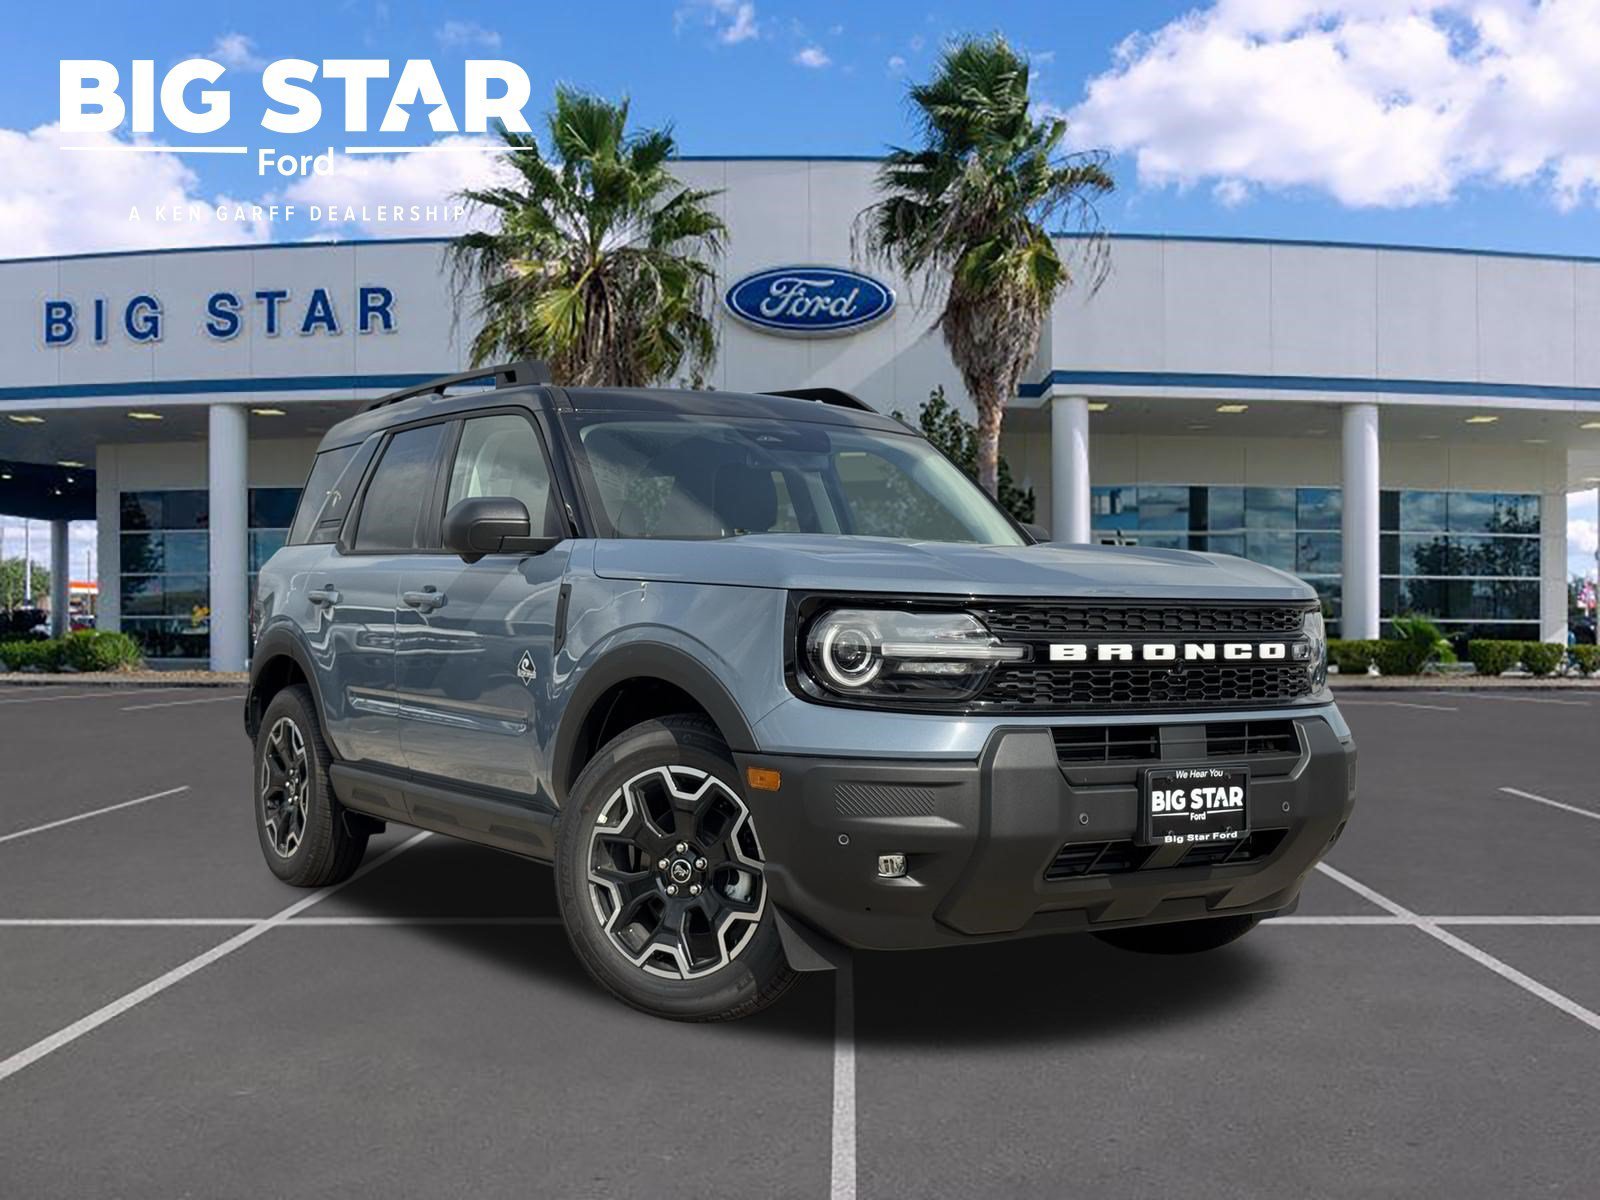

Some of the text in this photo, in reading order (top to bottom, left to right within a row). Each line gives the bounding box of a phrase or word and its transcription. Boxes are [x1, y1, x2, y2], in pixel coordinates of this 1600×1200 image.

[759, 277, 860, 317] Ford
[44, 286, 399, 345] BIG STAR
[1049, 643, 1286, 661] BRONCO
[1175, 769, 1223, 779] We Hear You
[1152, 786, 1243, 812] BIG STAR
[1190, 812, 1206, 820] Ford
[1164, 831, 1237, 844] Big Star Ford
